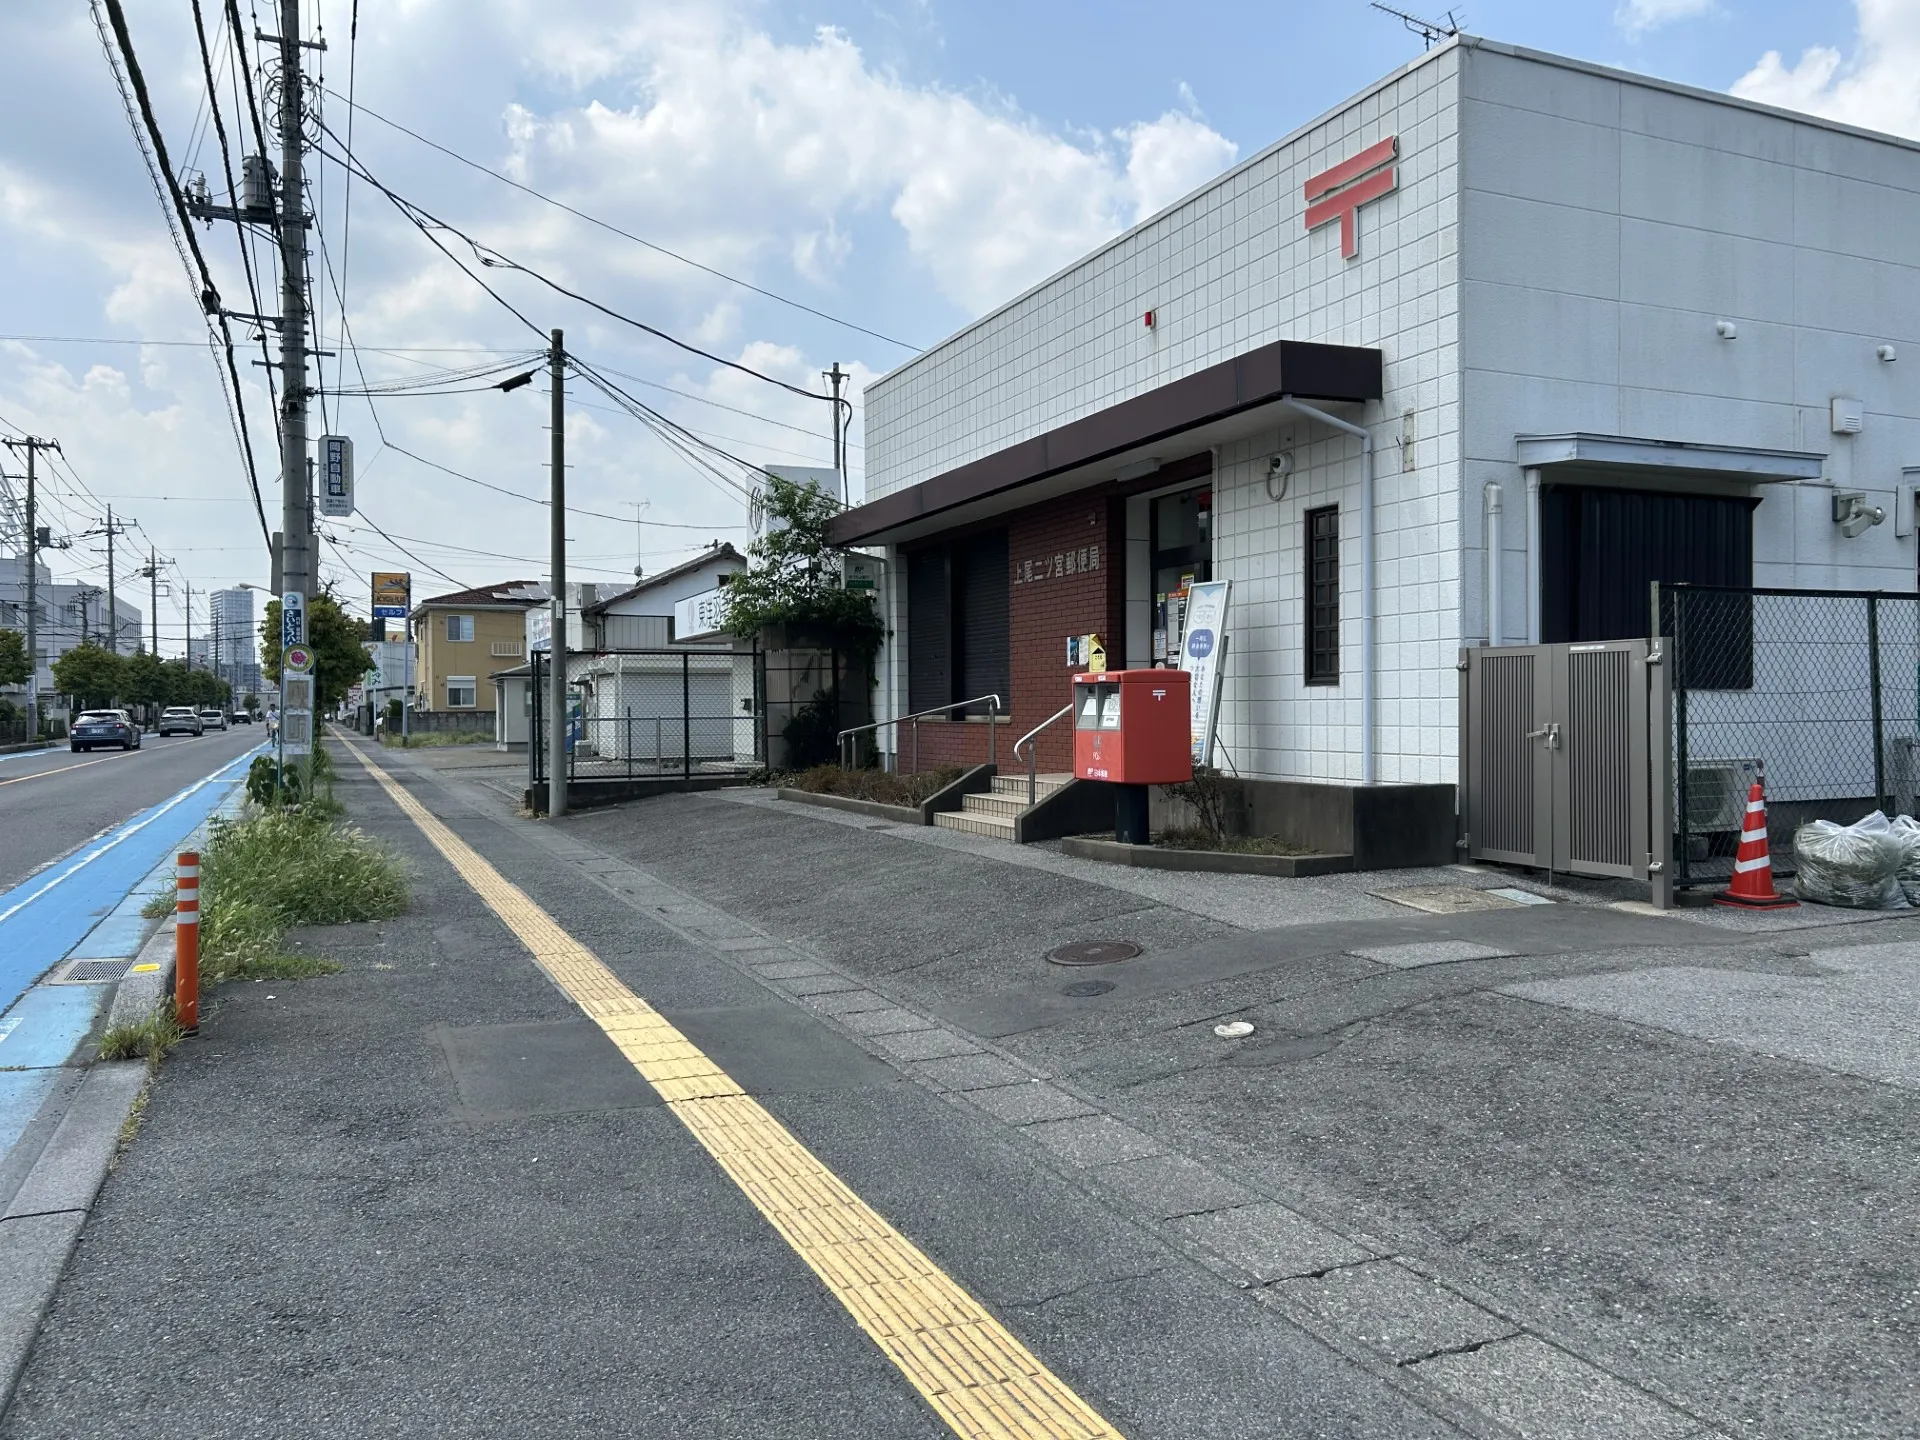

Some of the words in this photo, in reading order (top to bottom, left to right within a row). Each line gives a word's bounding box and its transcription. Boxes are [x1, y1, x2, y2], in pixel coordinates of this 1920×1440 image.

[329, 441, 341, 494] 岡野自動車
[1014, 545, 1100, 585] 上尾二ツ宮郵便局
[380, 608, 403, 617] セルフ
